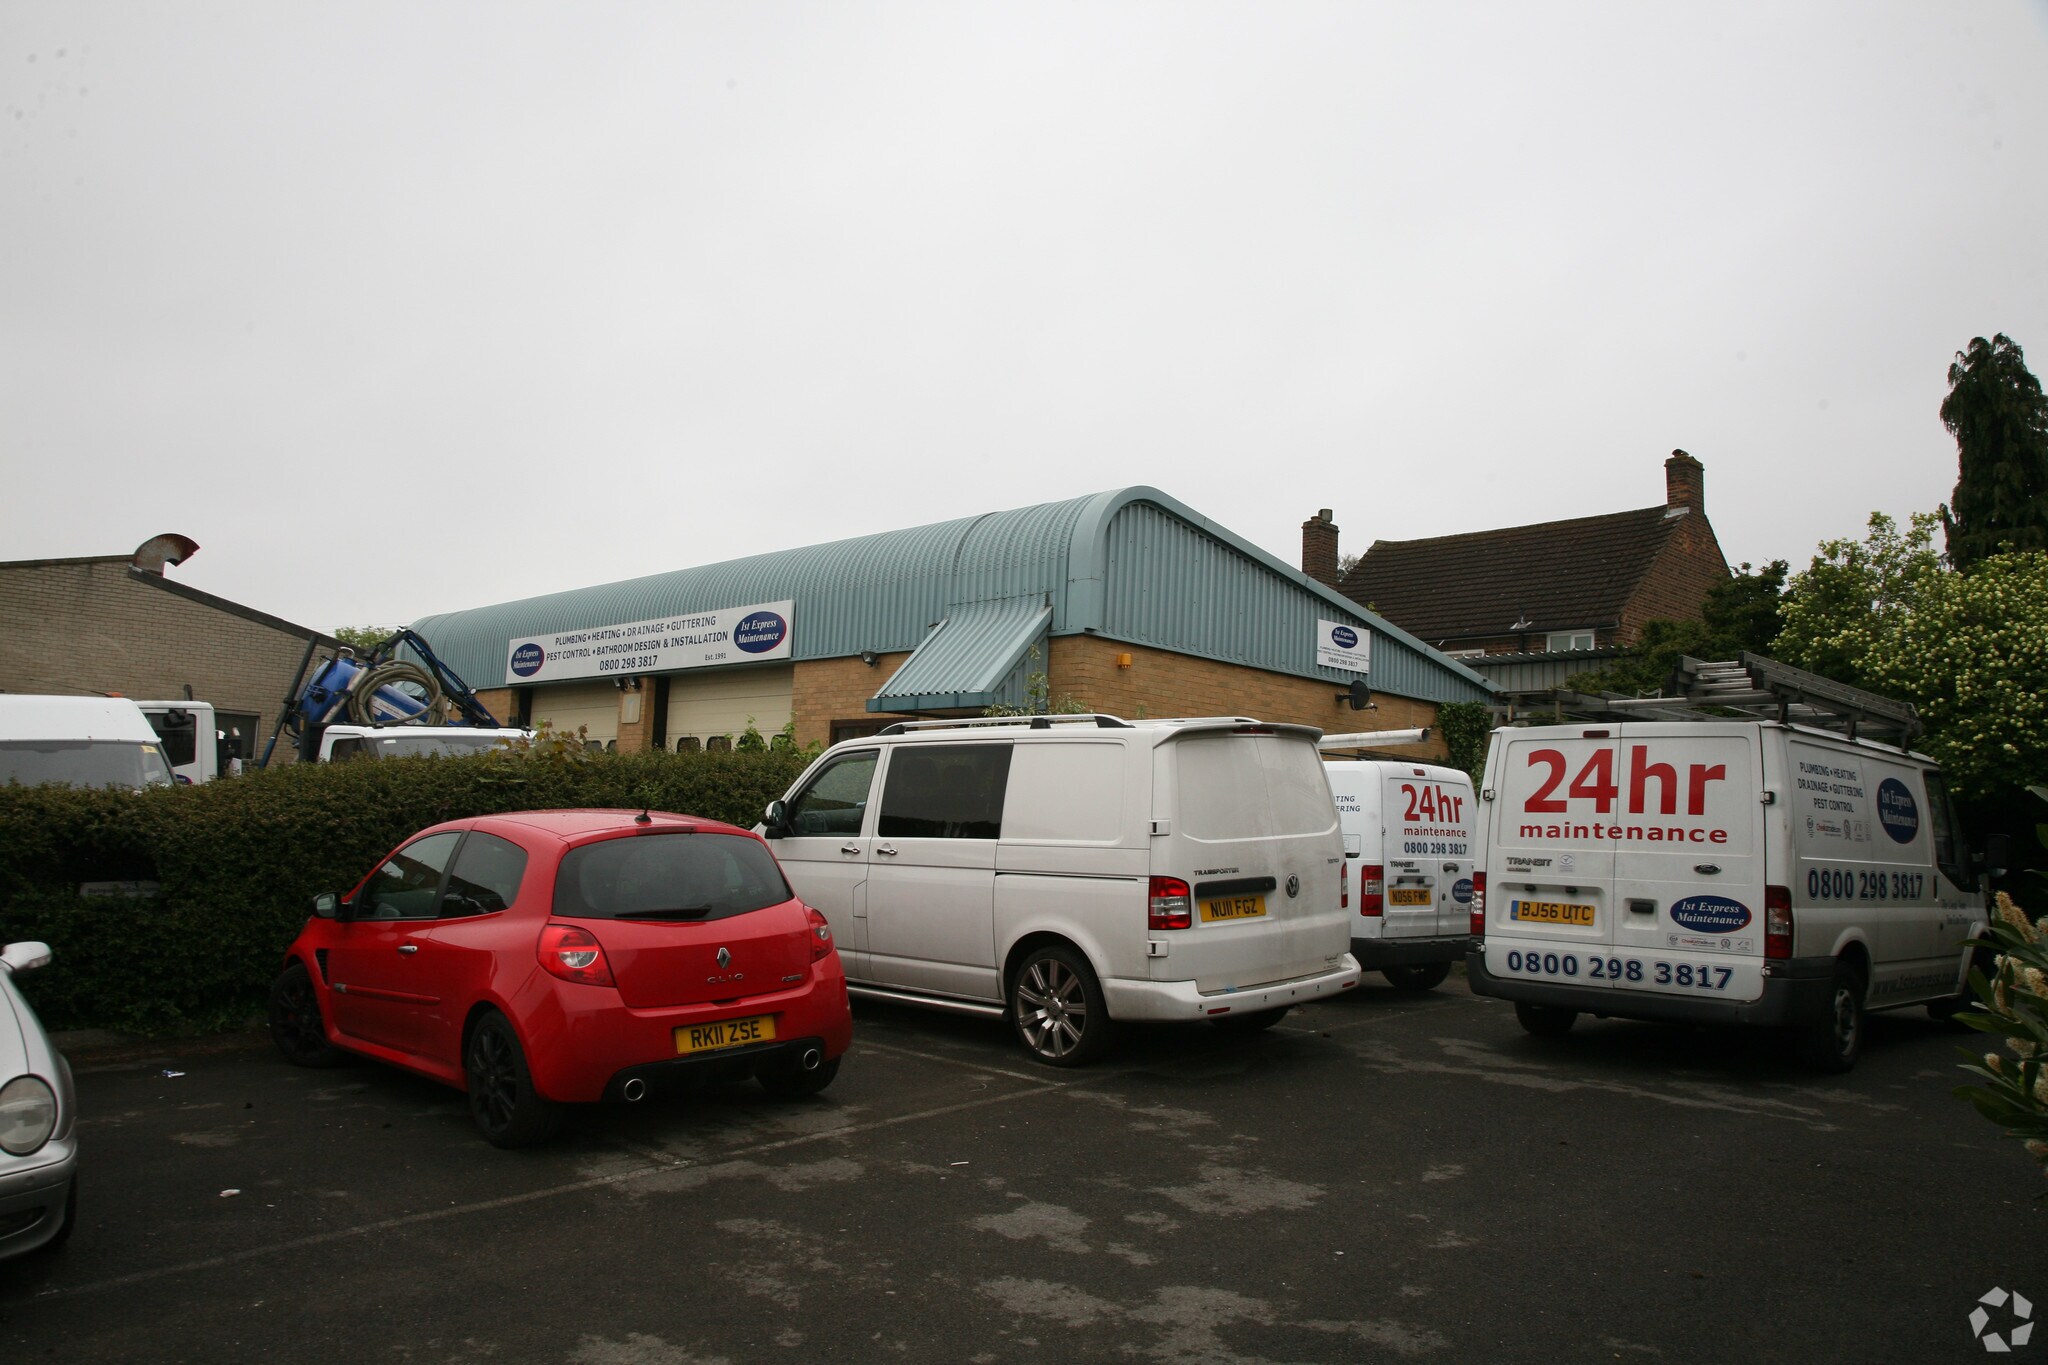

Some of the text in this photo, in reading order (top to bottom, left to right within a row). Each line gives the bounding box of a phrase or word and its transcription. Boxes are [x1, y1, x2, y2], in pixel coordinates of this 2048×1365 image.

[555, 616, 716, 646] PLUMBING HEATING DRAINAGE GUTTERING
[751, 619, 777, 631] Express
[546, 631, 729, 661] PEST CONTROL BATHROOM DESIGN & INSTALLATION
[737, 631, 780, 644] Maintenance
[522, 649, 539, 659] Express
[600, 655, 658, 671] 0800 298 3817
[715, 652, 727, 660] 1991
[513, 659, 540, 669] Maintenance
[1524, 745, 1726, 816] 24hr
[1800, 762, 1857, 781] PLUMBING HEATING
[1797, 778, 1864, 798] DRAINAGE GUTTERING
[1401, 783, 1463, 824] 24hr
[1813, 798, 1854, 813] PEST CONTROL
[1890, 790, 1913, 810] Express
[1882, 809, 1917, 828] Maintenance
[1404, 826, 1467, 838] maintenance
[1519, 821, 1728, 844] maintenance
[1404, 842, 1467, 855] 0800 298 3817
[1507, 857, 1552, 866] TRANSIT
[1808, 868, 1923, 900] 0800 298 3817
[1235, 898, 1258, 916] FGZ
[1521, 902, 1591, 921] BJ56 UTC
[1699, 902, 1740, 914] Express
[1677, 912, 1745, 925] Maintenance
[707, 973, 744, 983] CLIO
[1507, 951, 1733, 990] 0800 298 3817
[690, 1021, 761, 1048] RK11 ZSE
